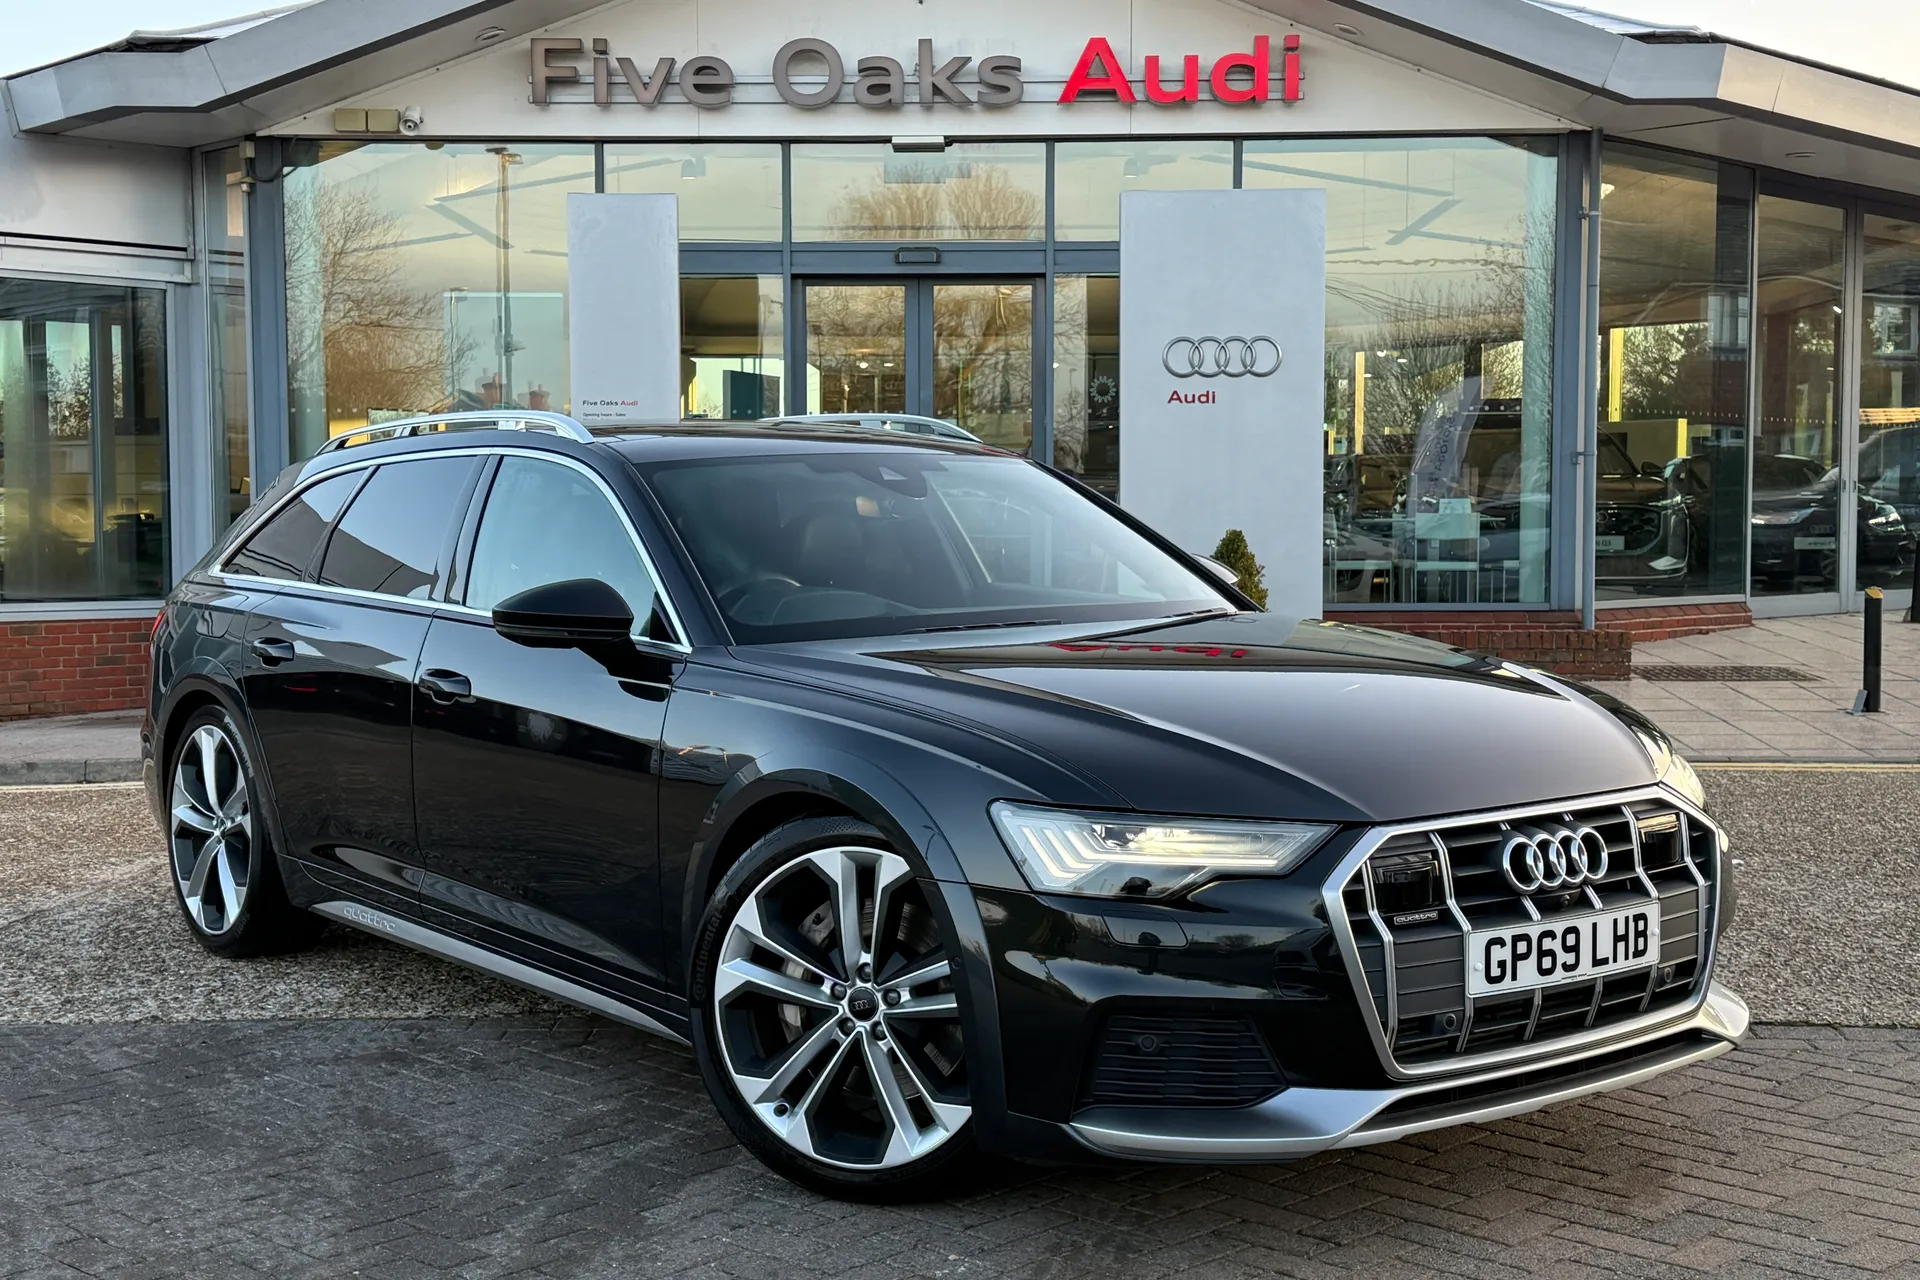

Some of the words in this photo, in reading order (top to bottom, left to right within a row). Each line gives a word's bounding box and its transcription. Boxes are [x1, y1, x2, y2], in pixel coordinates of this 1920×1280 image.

[530, 38, 736, 108] Five
[772, 37, 1023, 108] Oaks
[1057, 34, 1300, 104] Audi
[1167, 390, 1216, 404] Audi
[1396, 912, 1437, 923] quattro
[1484, 925, 1581, 985] GP69
[1592, 912, 1649, 968] LHB
